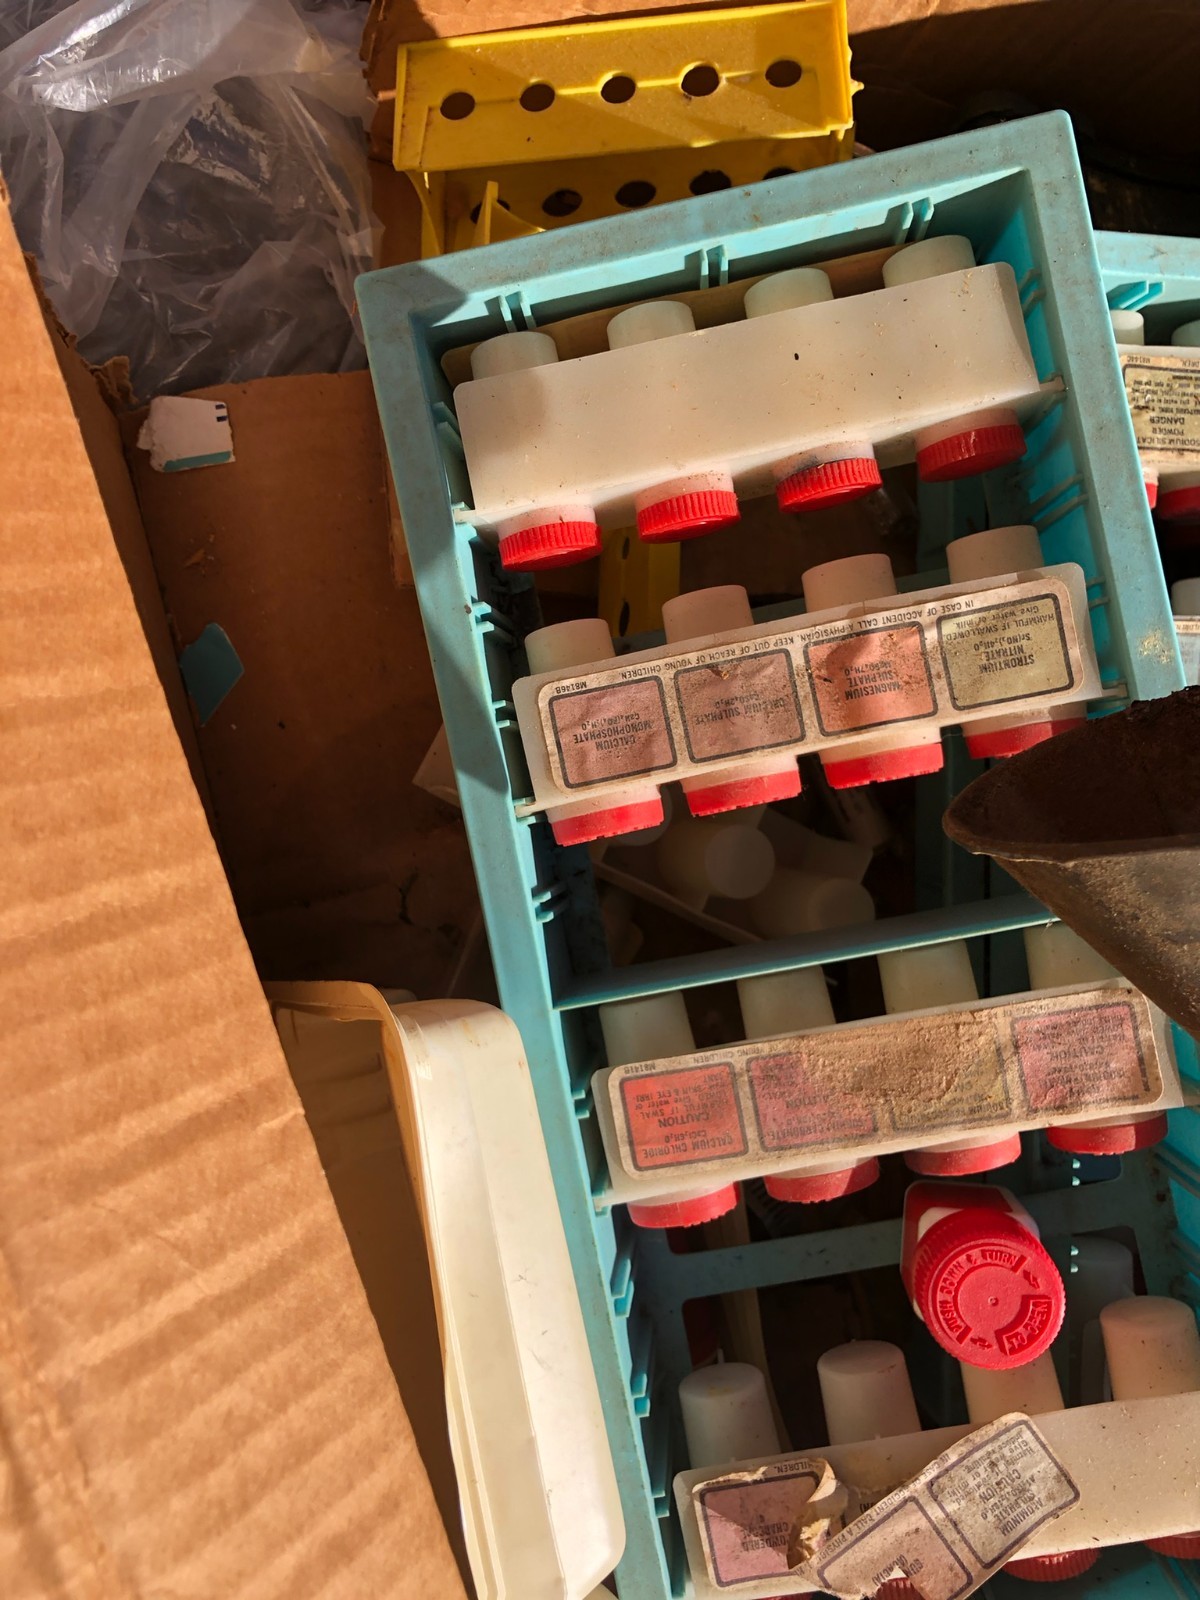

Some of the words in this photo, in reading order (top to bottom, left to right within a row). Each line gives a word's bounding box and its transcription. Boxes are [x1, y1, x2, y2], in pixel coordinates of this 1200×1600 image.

[1149, 414, 1184, 425] DANGER
[1151, 426, 1184, 435] POWDER
[1136, 435, 1166, 445] SILICAT
[924, 605, 937, 617] OF
[939, 600, 961, 613] CASE
[964, 598, 974, 608] IN
[1020, 604, 1039, 615] Give
[880, 607, 923, 626] ACCIDENT
[976, 615, 987, 623] or
[991, 609, 1015, 621] water
[1013, 612, 1054, 628] HARMFUL
[845, 622, 854, 633] A
[856, 617, 878, 630] CALL
[952, 618, 973, 629] milk.
[1000, 621, 1010, 630] IF
[773, 634, 794, 648] KEEP
[796, 623, 846, 643] PHYSICIAN.
[738, 644, 750, 654] OF
[751, 639, 770, 651] OUT
[983, 643, 1024, 661] NITRATE
[693, 653, 705, 664] OF
[707, 647, 736, 661] REACH
[663, 656, 691, 671] YOUNG
[978, 653, 1034, 675] STRONTIUM
[618, 663, 661, 681] CHILDREN.
[847, 668, 893, 687] SULPHATE
[554, 679, 587, 694] M8146B
[844, 679, 900, 700] MAGNESIUM
[743, 696, 785, 714] CALCIUM
[693, 706, 740, 725] SULPHATE
[572, 718, 651, 745] MONOPHOSPHATE
[595, 733, 636, 751] CALCIUM
[656, 1089, 671, 1098] EYE
[784, 1092, 829, 1108] AUTION
[647, 1098, 669, 1109] water
[670, 1105, 678, 1114] IF
[683, 1097, 728, 1112] HARMFUL
[657, 1109, 709, 1128] CAUTION
[641, 1141, 687, 1159] CHLORIDE
[691, 1134, 733, 1151] CALCIUM
[984, 1250, 1019, 1267] TURN
[940, 1260, 965, 1295] DOWN
[939, 1299, 963, 1333] PUSH
[1006, 1334, 1027, 1349] TO
[1023, 1302, 1047, 1335] OPEN
[997, 1430, 1023, 1452] induce
[1007, 1438, 1029, 1456] Give
[938, 1452, 951, 1466] IN
[982, 1453, 1007, 1473] water
[1003, 1445, 1034, 1470] Harmful
[773, 1460, 812, 1474] HILDREN.
[919, 1459, 943, 1480] CASE
[908, 1475, 923, 1489] OF
[970, 1470, 981, 1481] or
[977, 1467, 1022, 1504] CAUTION
[874, 1484, 912, 1514] ACCIDENT
[991, 1488, 1036, 1524] SULPHATE
[854, 1512, 874, 1530] CALL
[996, 1496, 1046, 1536] ALUMINUM
[845, 1528, 853, 1537] A
[741, 1533, 789, 1552] OWDERED
